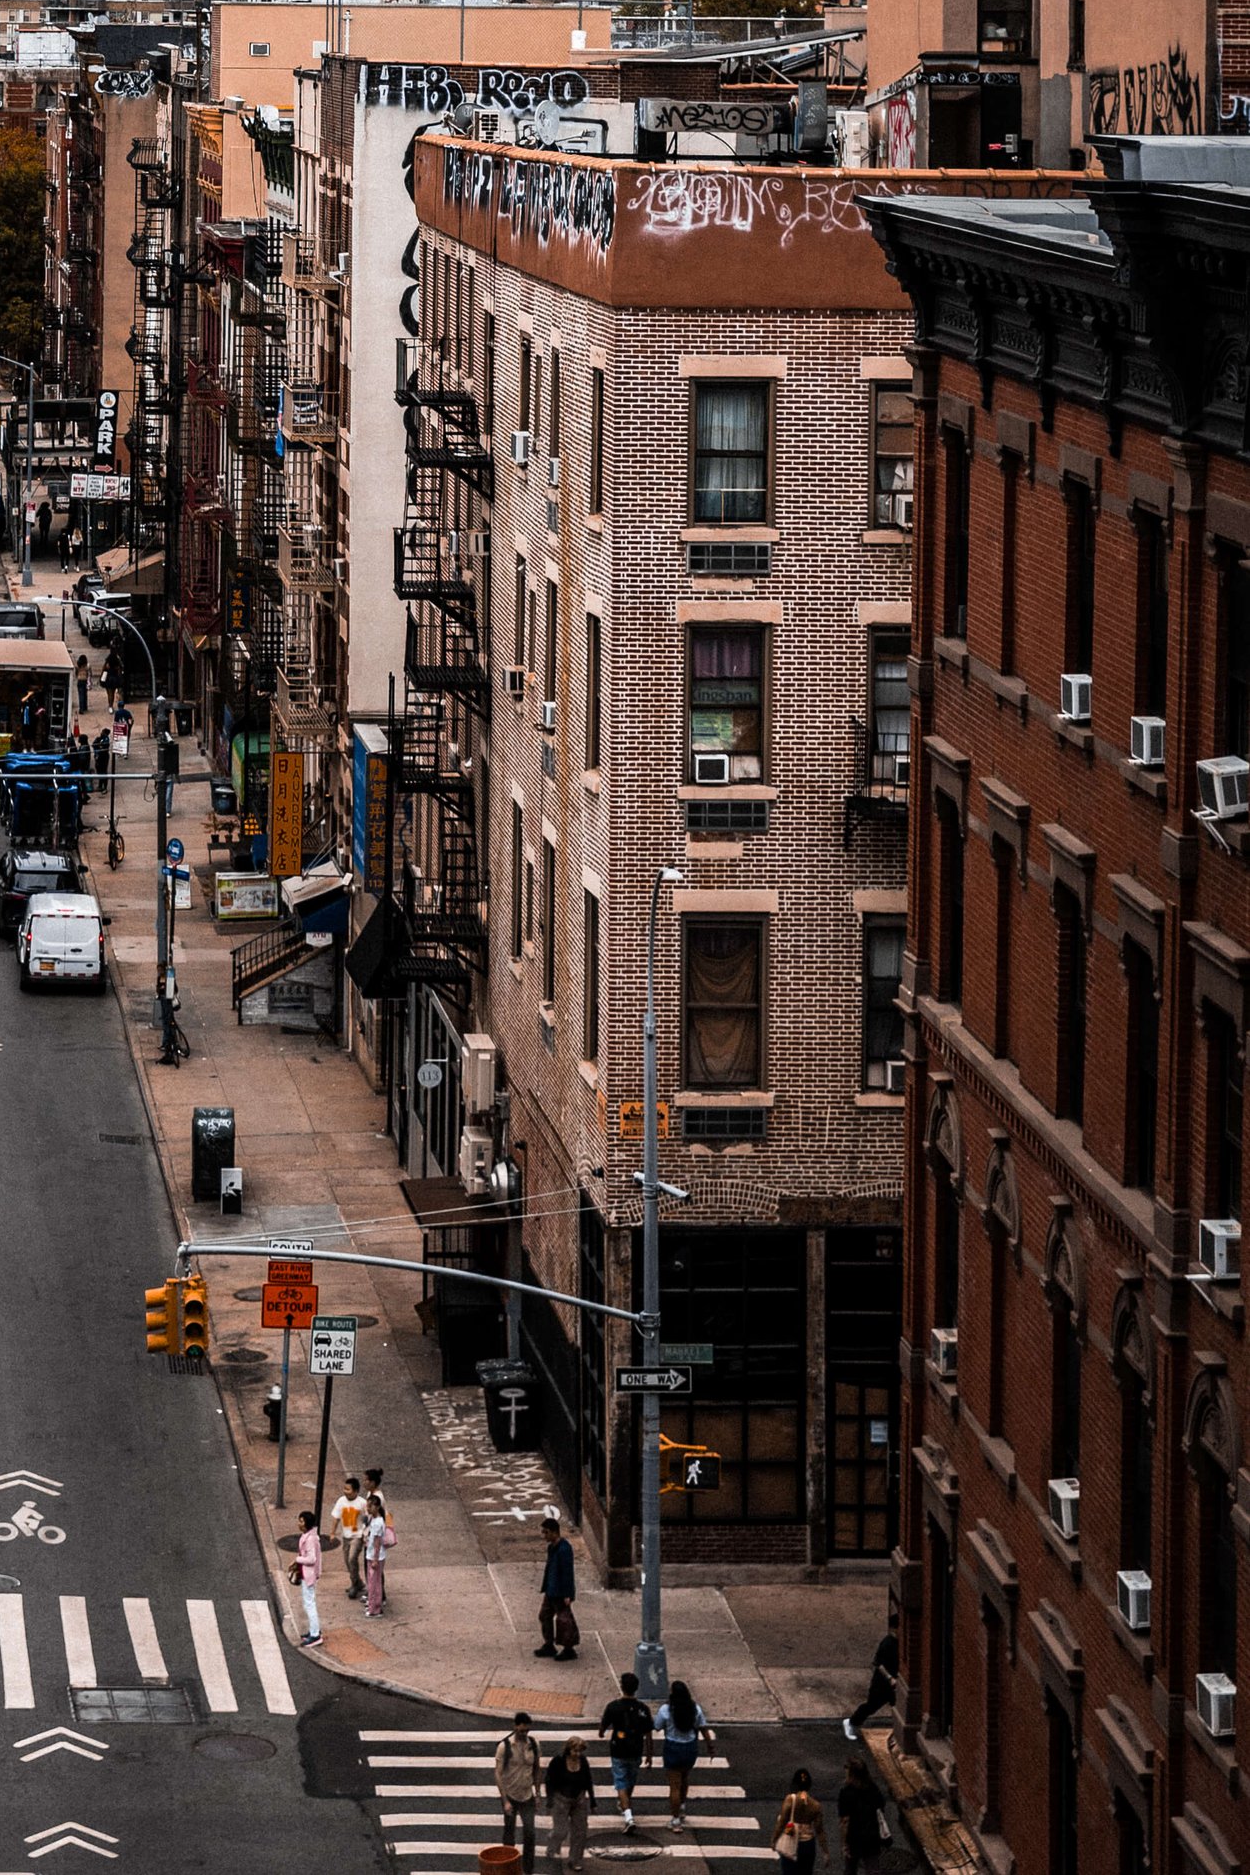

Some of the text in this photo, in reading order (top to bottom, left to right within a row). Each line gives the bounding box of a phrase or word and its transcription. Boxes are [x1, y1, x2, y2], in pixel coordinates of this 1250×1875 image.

[97, 408, 115, 454] PARK
[275, 758, 289, 871] 日月洗衣店
[290, 759, 301, 871] LAUNDROMAT
[422, 1071, 439, 1081] 113
[290, 1264, 310, 1272] RIVER
[271, 1272, 309, 1281] GREENWAY
[266, 1301, 313, 1313] DETOUR
[315, 1319, 354, 1329] BIKE ROUTE
[313, 1348, 352, 1360] SHARED
[319, 1361, 344, 1371] LANE
[626, 1374, 680, 1385] ONE WAY
